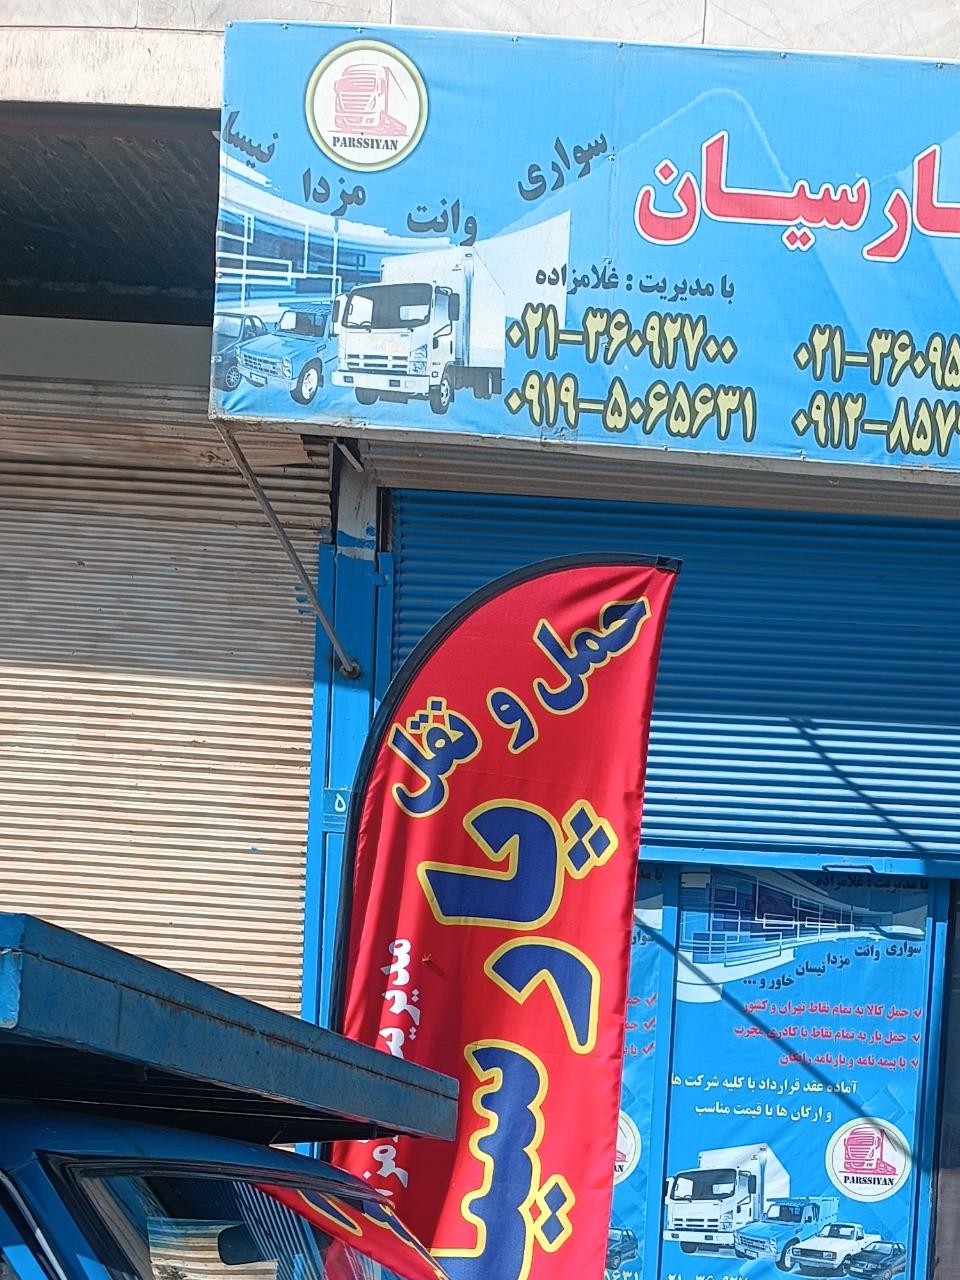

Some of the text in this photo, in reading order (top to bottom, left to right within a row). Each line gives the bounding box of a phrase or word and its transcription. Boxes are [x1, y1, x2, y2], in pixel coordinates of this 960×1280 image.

[331, 136, 398, 151] PARSSIYAN
[222, 110, 609, 246] سواری وانت مزدا نیسا
[535, 263, 619, 295] غلامزاده
[639, 274, 715, 302] مدیریت
[721, 274, 735, 305] با
[506, 303, 737, 370] ۰۲۱-۳۶۰۹۲۷۰۰
[505, 371, 756, 441] ۰۹۱۹-۵۰۶۵۶۳۱
[387, 596, 651, 818] حمل و نقل
[631, 929, 656, 945] سوار
[854, 944, 880, 960] وانت
[885, 941, 922, 957] سواری
[827, 952, 850, 969] مزدا
[795, 961, 826, 977] نیسان
[759, 978, 766, 988] و
[768, 974, 794, 989] خاور
[379, 937, 420, 1059] مدیری
[807, 1001, 830, 1013] نقاط
[832, 1004, 851, 1017] تمام
[855, 1007, 863, 1018] به
[866, 1004, 884, 1016] کالا
[886, 1005, 908, 1021] حمل
[801, 1027, 808, 1039] با
[810, 1027, 832, 1039] نقاط
[834, 1029, 854, 1043] تمام
[857, 1032, 866, 1041] به
[869, 1030, 882, 1044] بار
[884, 1030, 906, 1045] حمل
[898, 1056, 906, 1071] با
[684, 1074, 719, 1091] شرکت
[722, 1076, 745, 1092] کلیه
[747, 1077, 756, 1093] با
[758, 1078, 801, 1096] قرارداد
[803, 1081, 823, 1093] عقد
[827, 1080, 858, 1094] آماده
[695, 1101, 730, 1115] مناسب
[733, 1102, 762, 1119] قیمت
[765, 1104, 773, 1119] با
[776, 1104, 787, 1116] ها
[825, 1110, 832, 1123] و
[843, 1174, 895, 1187] PARSSIYAN
